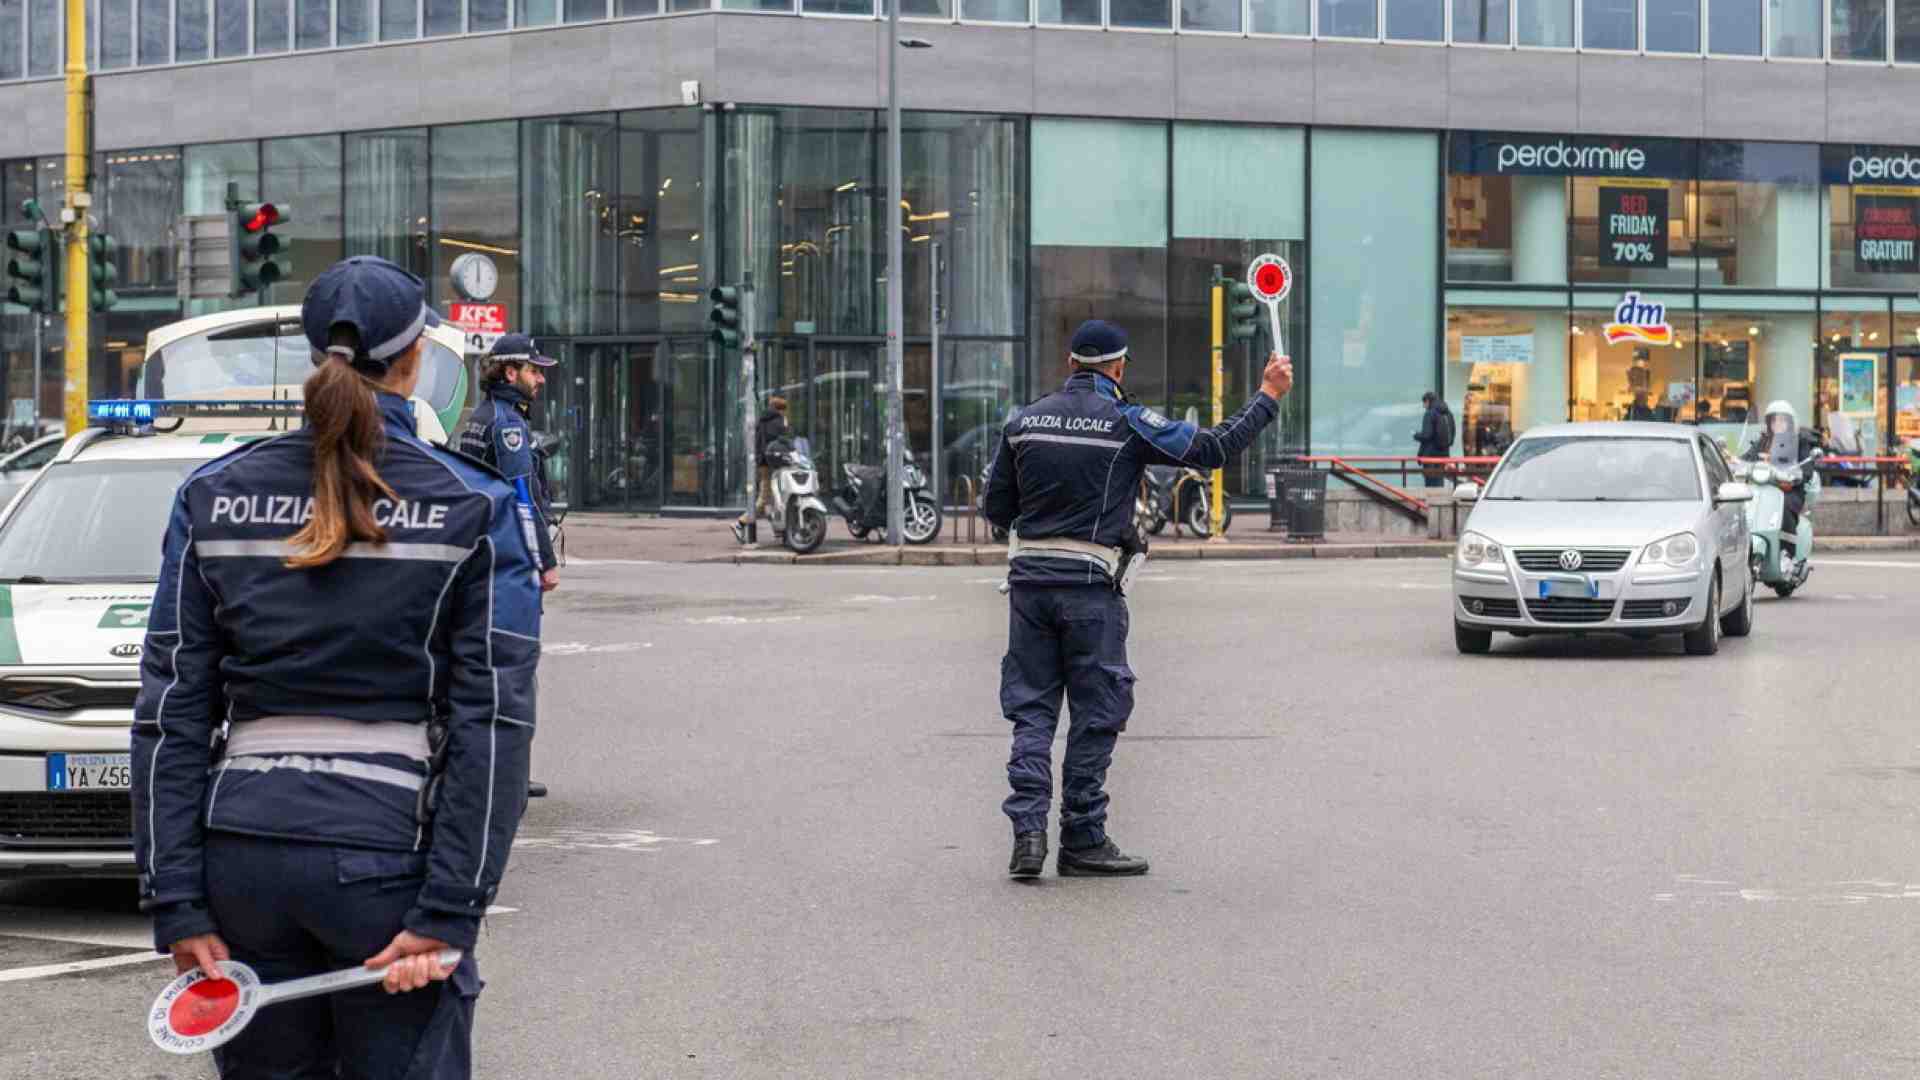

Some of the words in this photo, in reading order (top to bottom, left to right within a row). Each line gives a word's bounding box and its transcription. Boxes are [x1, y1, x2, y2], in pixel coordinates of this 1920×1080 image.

[1498, 140, 1646, 172] perdormire
[1612, 242, 1654, 262] 70%
[1861, 240, 1914, 262] GRATUITI
[459, 305, 498, 321] KFC
[1617, 296, 1663, 325] dm
[1020, 415, 1062, 429] POLIZIA
[1066, 417, 1113, 432] LOCALE
[210, 496, 316, 525] POLIZIA
[371, 499, 449, 529] CALE
[115, 644, 143, 656] KIA
[68, 767, 89, 787] YA
[98, 767, 130, 787] 456
[164, 971, 207, 1001] MILAN
[153, 1007, 168, 1020] DI
[155, 1025, 206, 1048] COMUNE
